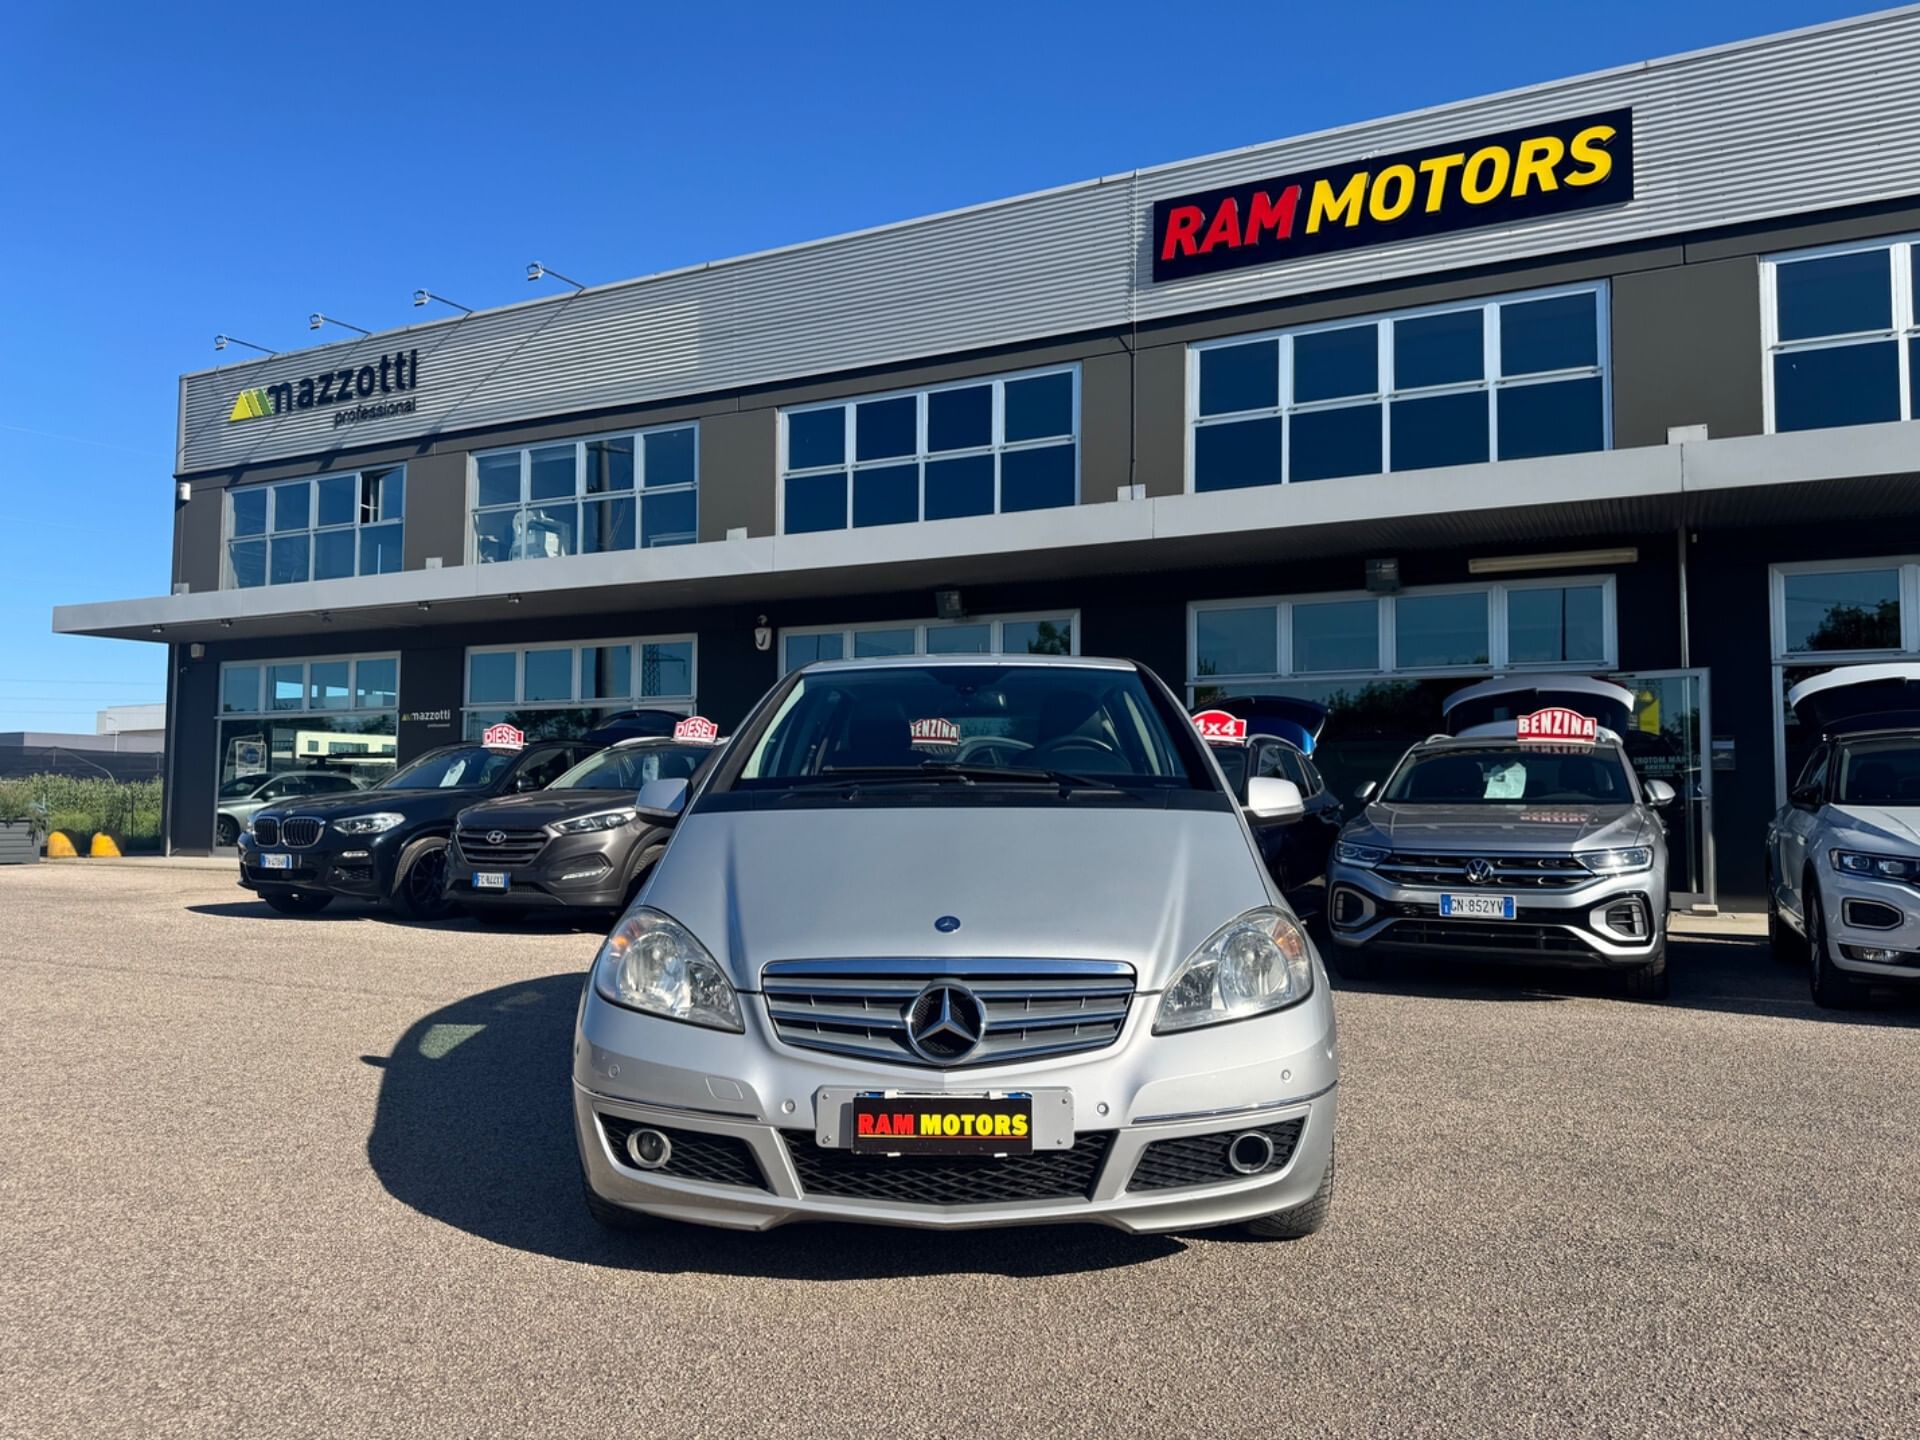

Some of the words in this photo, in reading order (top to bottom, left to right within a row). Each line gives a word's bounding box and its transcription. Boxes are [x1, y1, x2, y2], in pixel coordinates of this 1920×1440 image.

[1161, 185, 1301, 260] RAM
[1305, 125, 1617, 234] MOTORS
[267, 349, 417, 414] mazzotti
[334, 397, 417, 429] professional
[412, 709, 450, 720] mazzotti
[1518, 711, 1594, 735] BENZINA
[484, 727, 523, 744] DIESEL
[676, 720, 716, 737] DIESEL
[858, 1113, 914, 1135] RAM
[920, 1113, 1028, 1136] MOTORS
